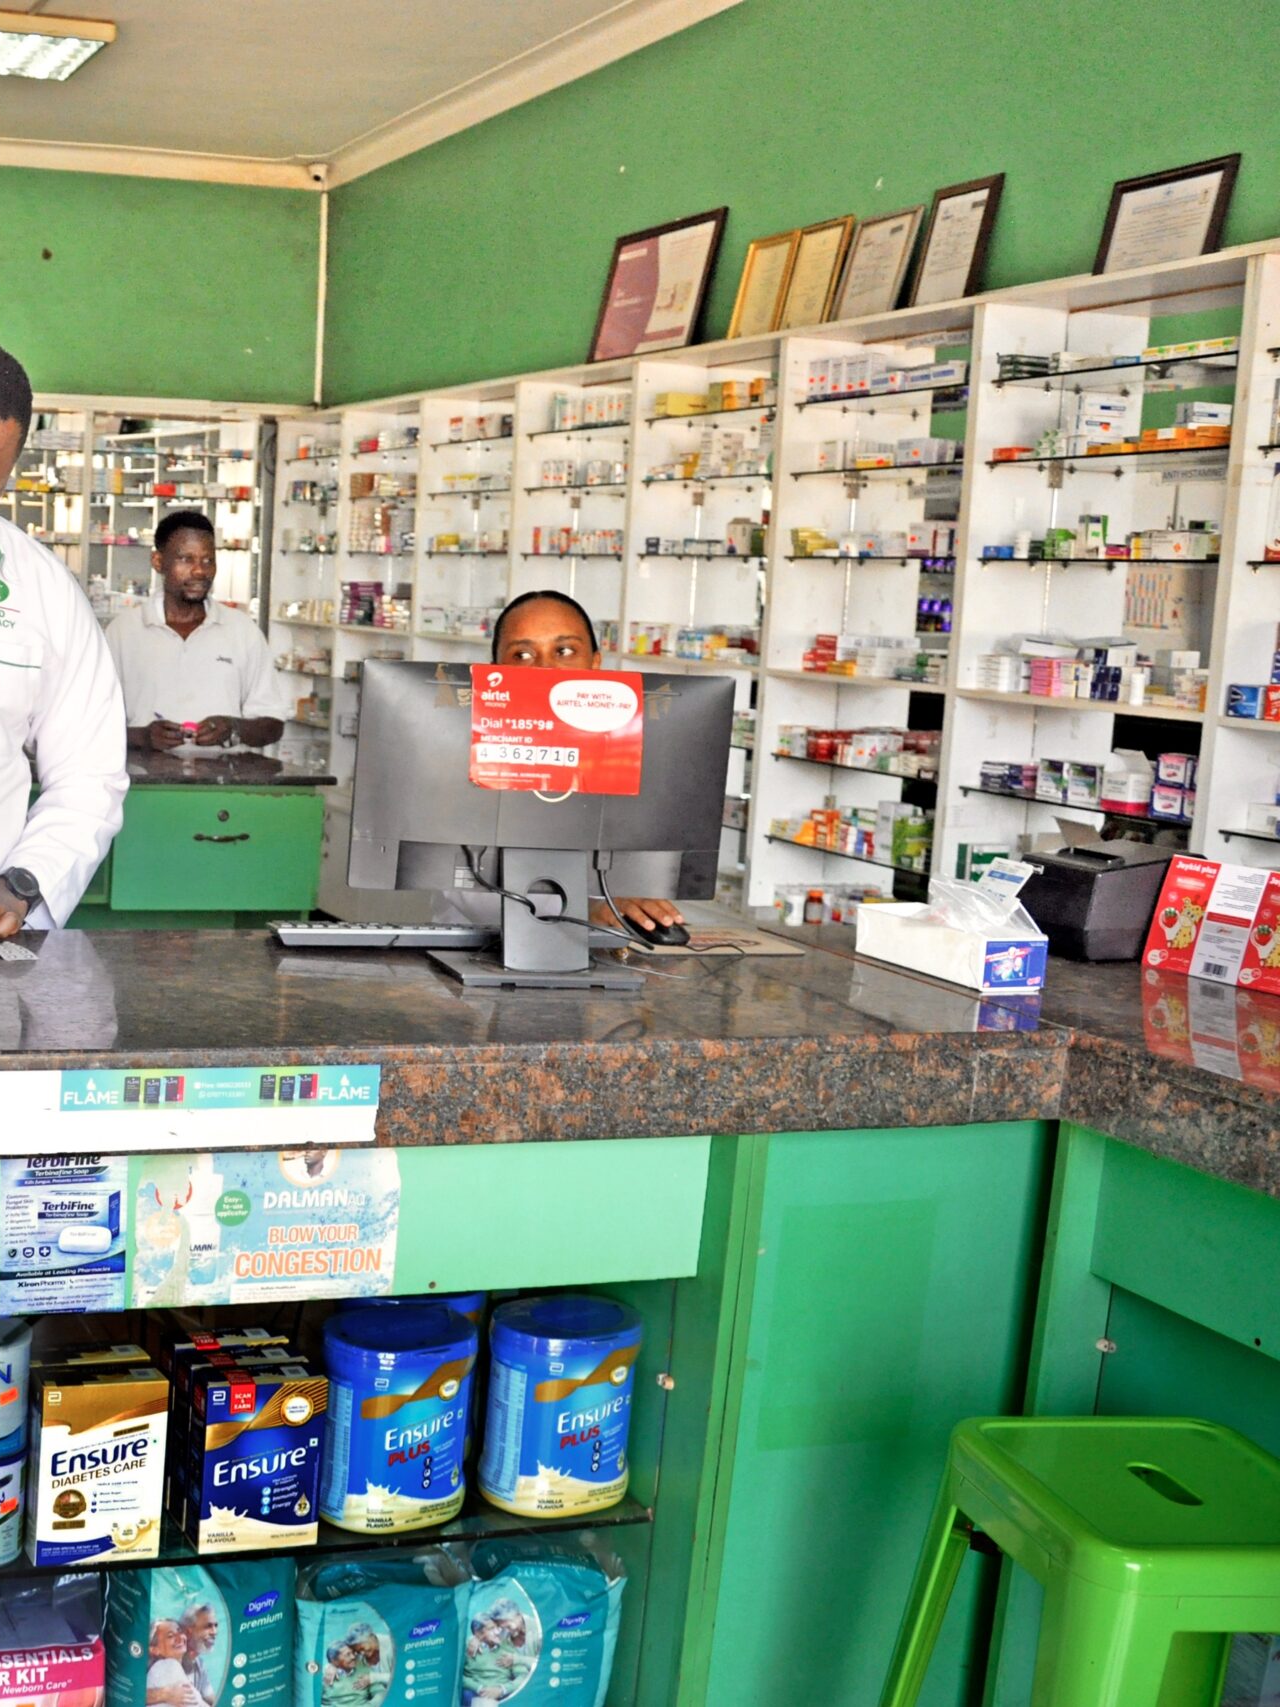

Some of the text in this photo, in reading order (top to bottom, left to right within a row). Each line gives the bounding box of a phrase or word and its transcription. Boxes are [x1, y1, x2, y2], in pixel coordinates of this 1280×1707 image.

[481, 690, 510, 702] airtel
[480, 718, 502, 729] Dial
[480, 736, 523, 744] MERCHANT
[64, 1091, 119, 1104] FLAME
[319, 1086, 371, 1101] FLAME
[27, 1156, 101, 1168] TerbiFine
[34, 1168, 89, 1177] Terbinafine Soap
[42, 1201, 95, 1211] TerbiFine
[263, 1189, 348, 1210] DALMAN
[217, 1209, 248, 1218] applicator
[269, 1225, 358, 1243] BLOW YOUR
[53, 1267, 76, 1275] Leading
[77, 1266, 111, 1274] Pharmacies
[235, 1249, 382, 1277] CONGESTION
[557, 1396, 623, 1434] Ensure
[384, 1411, 454, 1451] Ensure
[560, 1425, 600, 1450] PLUS
[51, 1438, 148, 1477] Ensure
[387, 1440, 430, 1467] PLUS
[52, 1458, 147, 1489] DIABETES CARE
[213, 1446, 306, 1487] Ensure
[248, 1597, 277, 1612] Dignity
[239, 1612, 283, 1633] premium
[413, 1621, 439, 1636] Dignity
[562, 1615, 587, 1627] Dignity
[552, 1629, 592, 1641] premium
[404, 1636, 444, 1652] premium
[16, 1668, 49, 1684] KIT
[2, 1684, 44, 1696] Newborn
